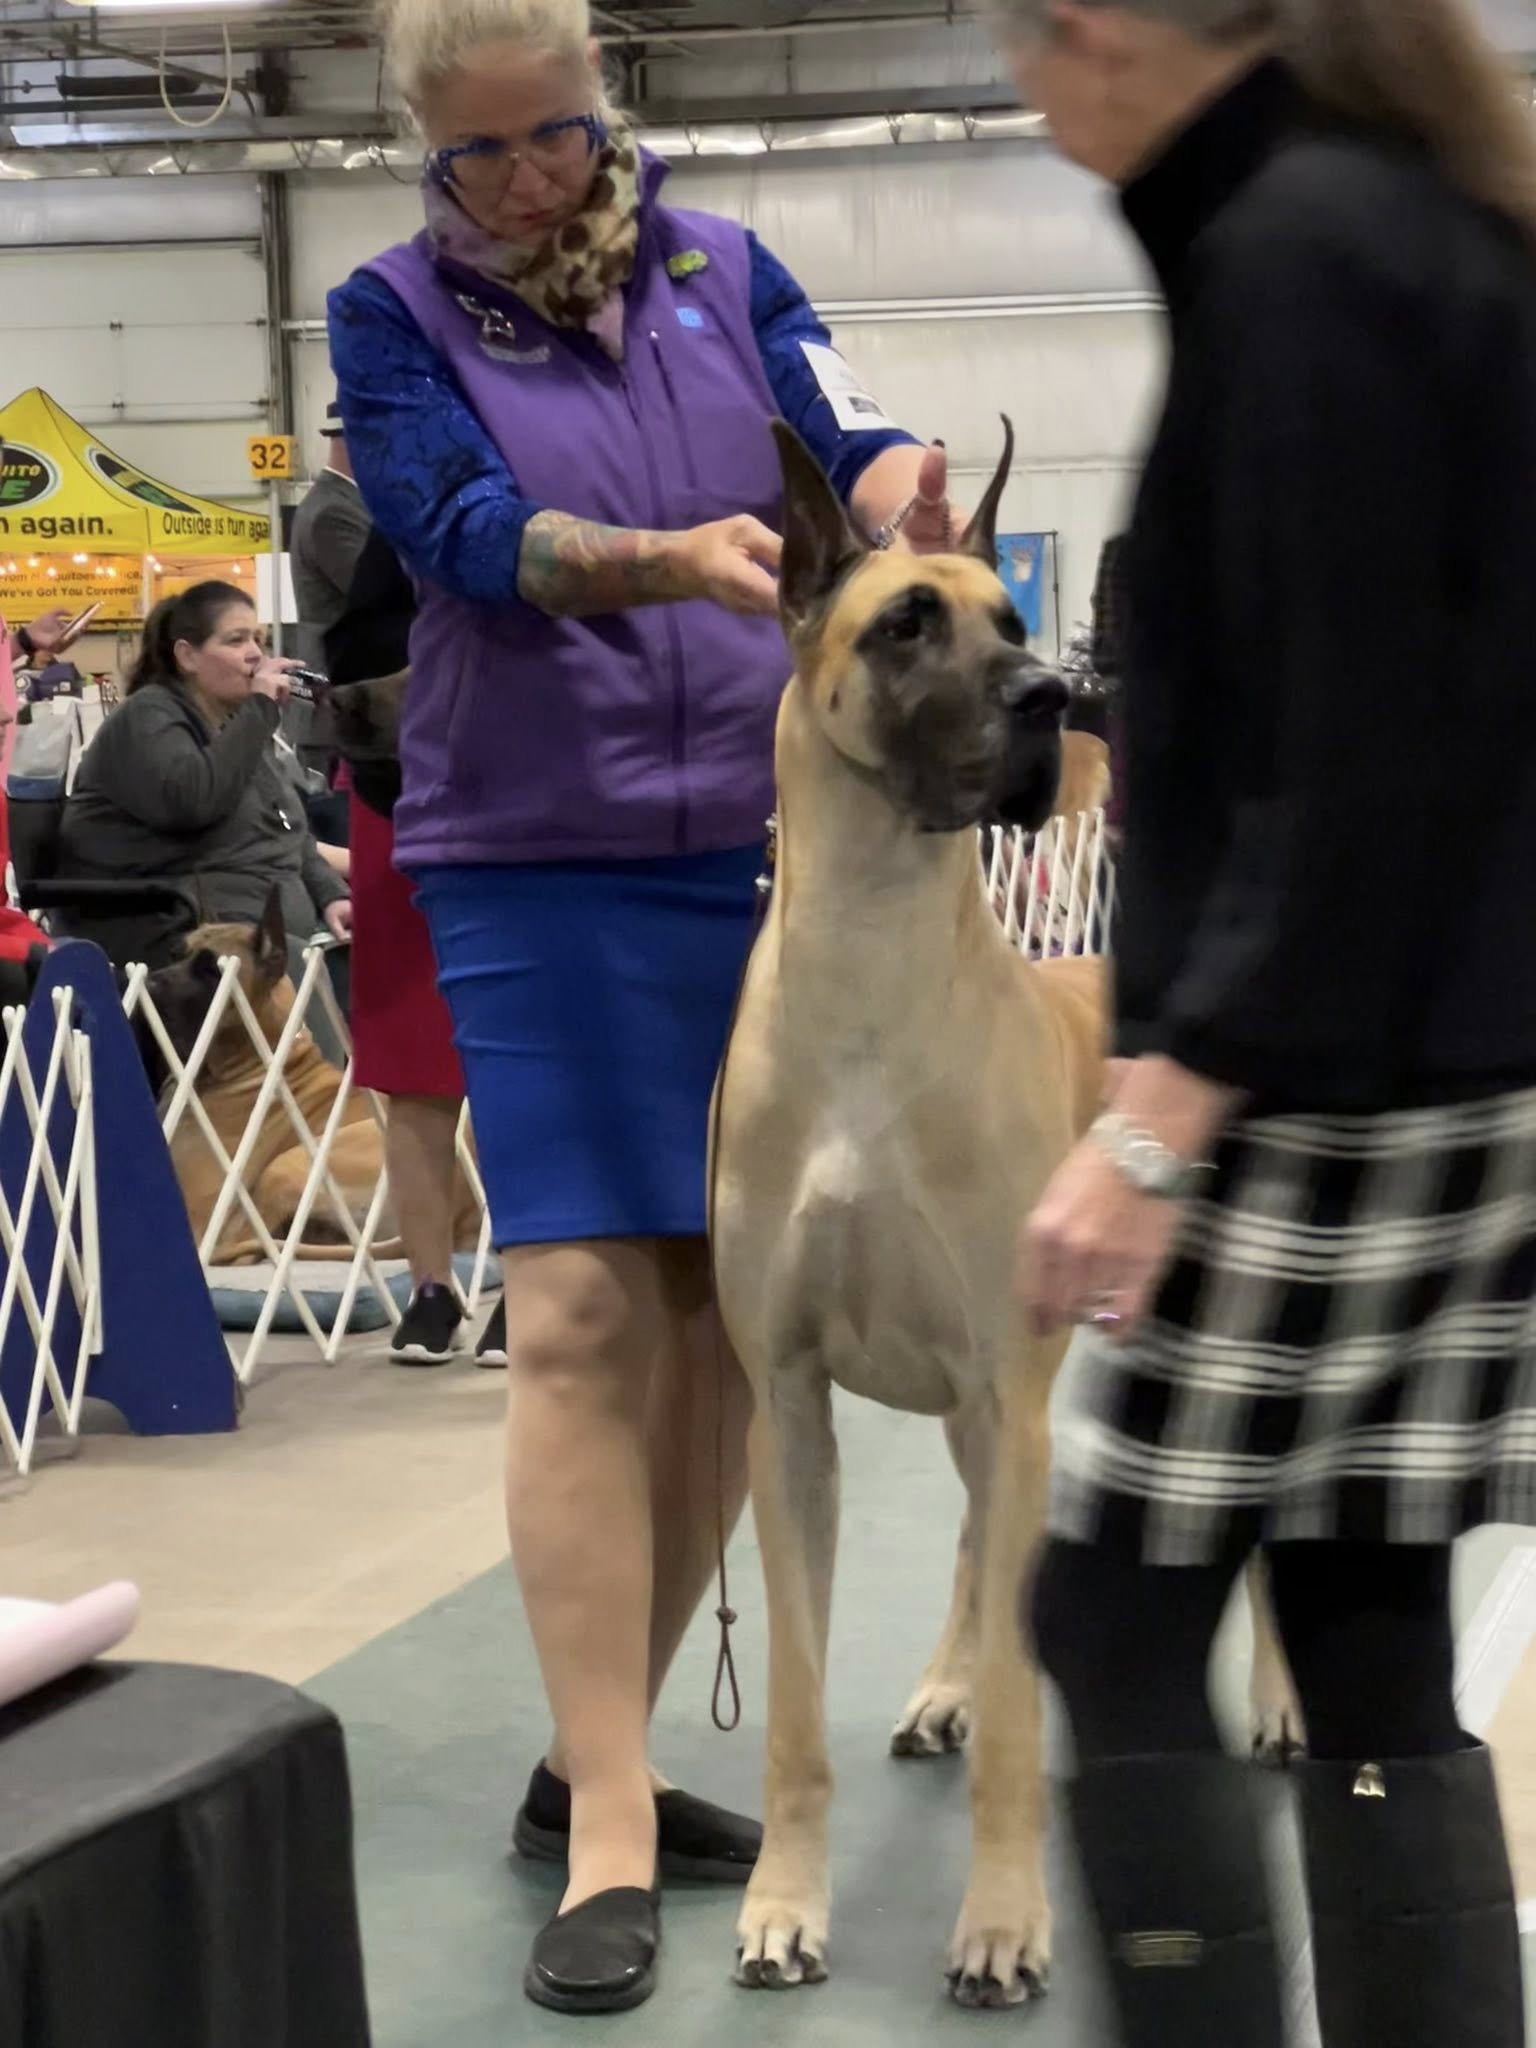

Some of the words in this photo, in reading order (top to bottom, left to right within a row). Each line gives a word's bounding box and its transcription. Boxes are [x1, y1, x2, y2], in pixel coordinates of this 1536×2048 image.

[251, 443, 286, 470] 32
[21, 514, 113, 539] again.
[163, 511, 211, 535] Outside
[215, 517, 224, 535] is
[36, 586, 57, 597] Got
[61, 587, 82, 597] You
